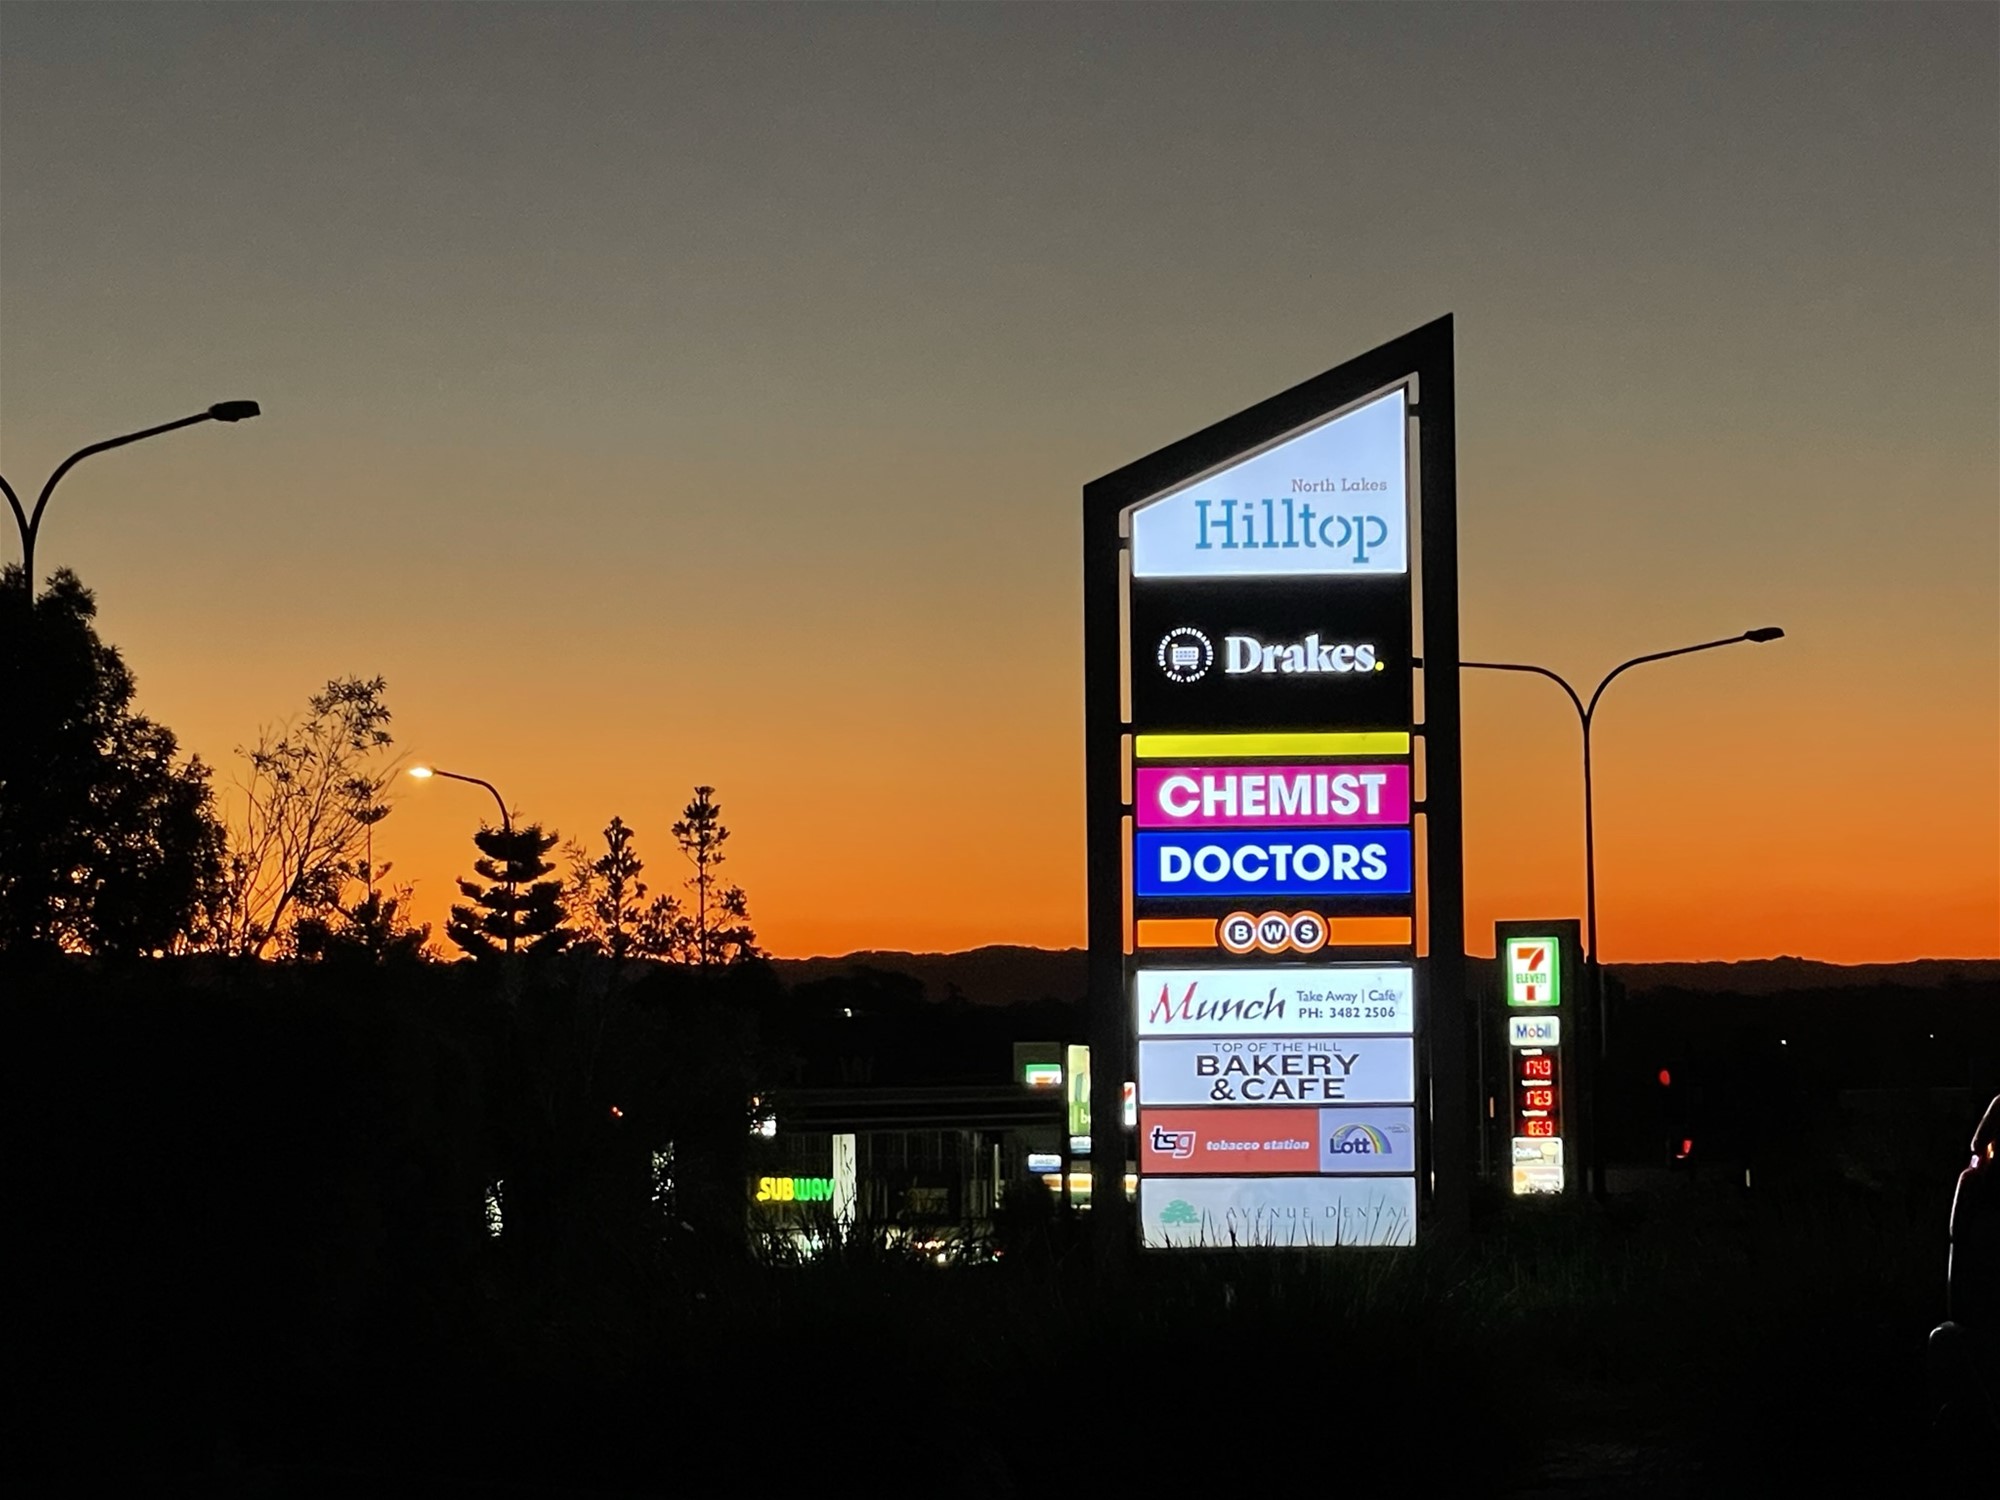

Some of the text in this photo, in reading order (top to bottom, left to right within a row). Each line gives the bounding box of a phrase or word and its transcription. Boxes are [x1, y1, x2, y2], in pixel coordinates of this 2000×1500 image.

[1291, 477, 1388, 492] North Lakes
[1195, 498, 1388, 563] Hilltop
[1159, 774, 1386, 817] CHEMIST
[1160, 843, 1387, 882] DOCTORS
[1149, 981, 1286, 1024] Munch
[1296, 990, 1323, 1002] Take
[1325, 990, 1357, 1004] Away
[1299, 1006, 1395, 1018] PH: 3482 2506
[1516, 1023, 1552, 1038] Mobil
[1212, 1042, 1342, 1053] TOP OF THE HILL
[1196, 1053, 1360, 1076] BAKERY
[1151, 1126, 1309, 1158] tsg tobacco station
[1330, 1137, 1371, 1154] Lott
[756, 1177, 836, 1201] SUBWAY
[1227, 1206, 1409, 1219] AVENUE DENTAL
